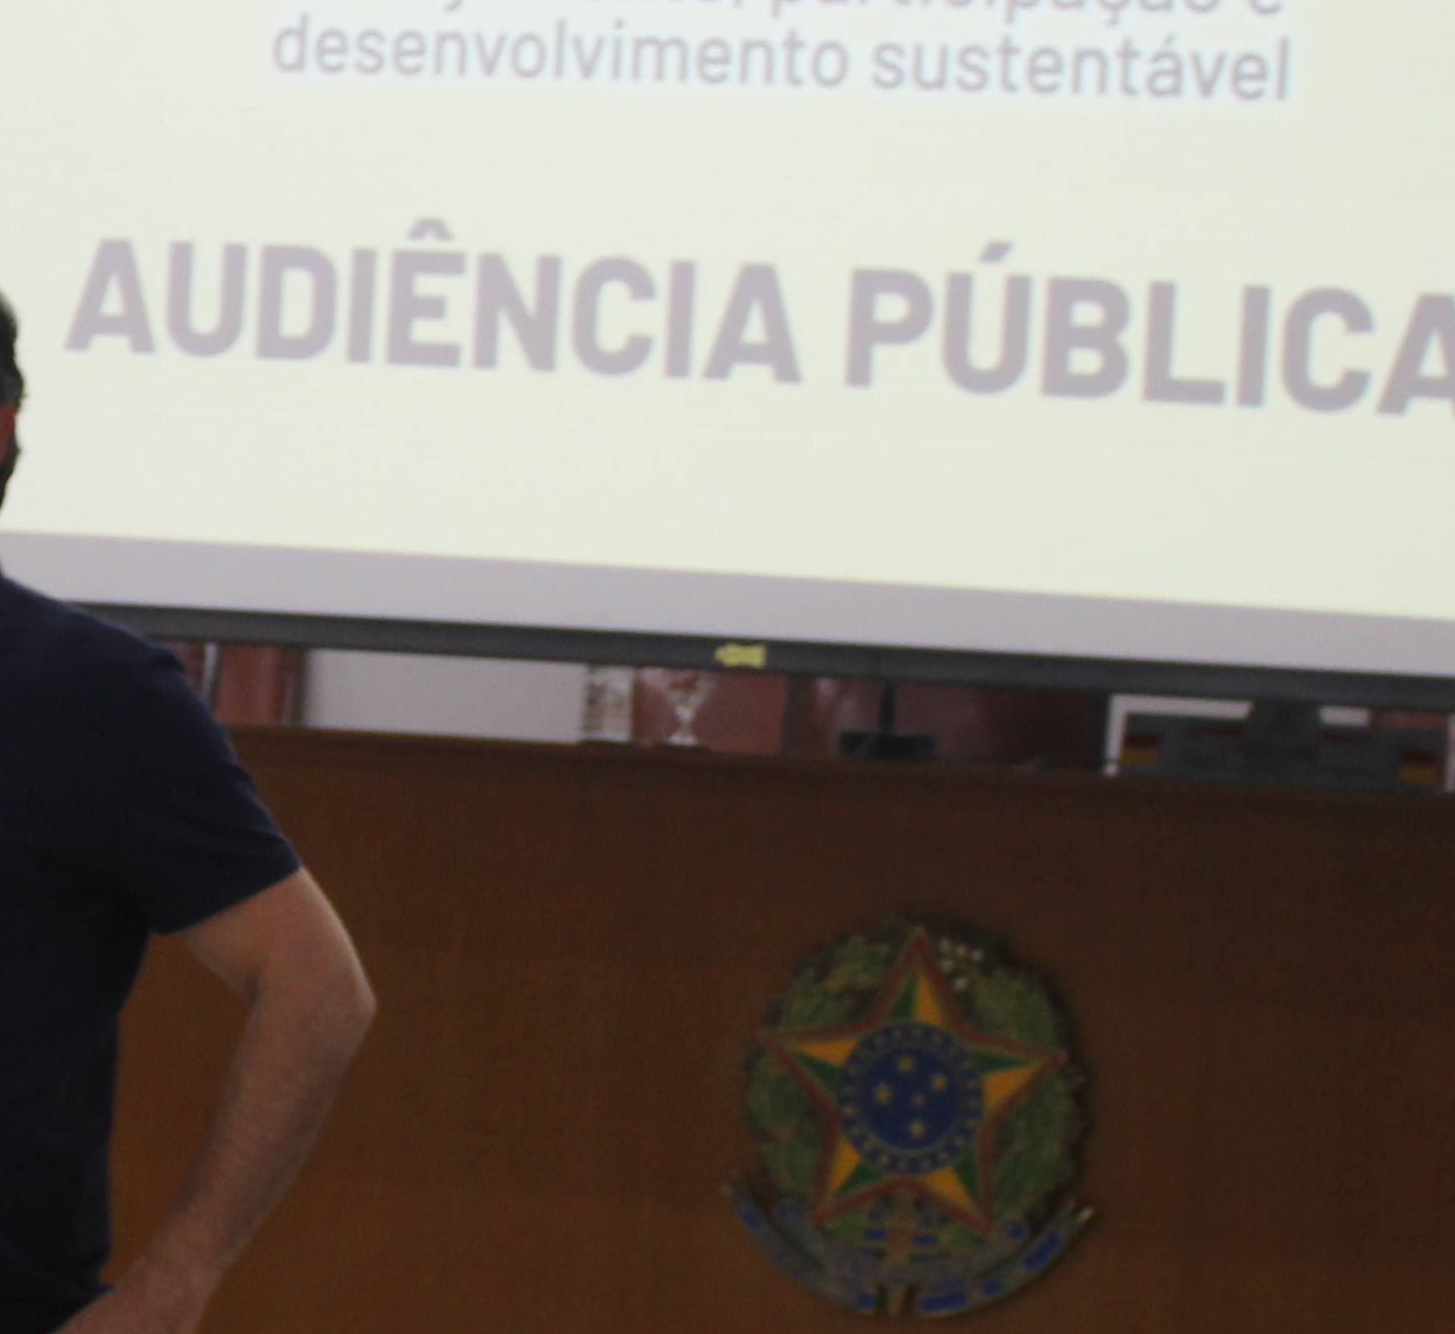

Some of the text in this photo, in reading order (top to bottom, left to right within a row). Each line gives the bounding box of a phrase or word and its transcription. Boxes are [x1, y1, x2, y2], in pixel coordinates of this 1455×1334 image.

[272, 13, 1293, 103] desenvolvimento sustentável
[63, 217, 803, 385] AUDIÊNCIA
